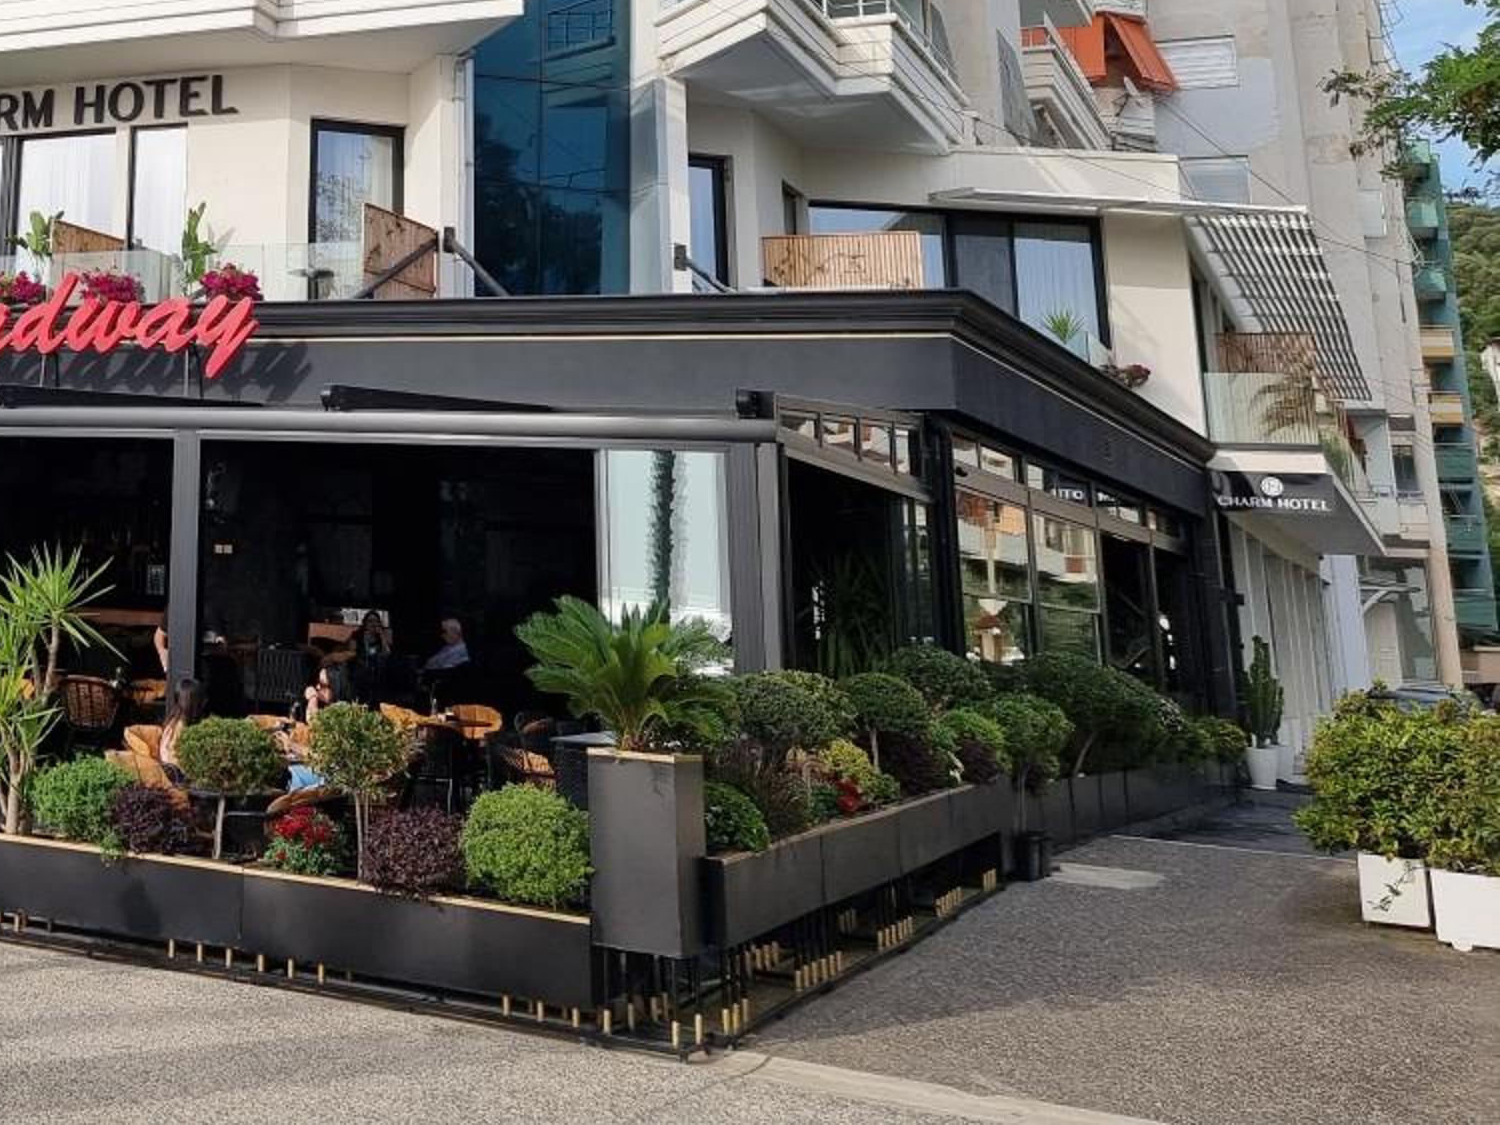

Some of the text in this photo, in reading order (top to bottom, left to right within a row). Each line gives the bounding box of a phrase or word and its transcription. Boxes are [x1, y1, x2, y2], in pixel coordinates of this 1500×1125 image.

[73, 74, 239, 124] HOTEL
[1218, 496, 1332, 512] CHARM HOTEL
